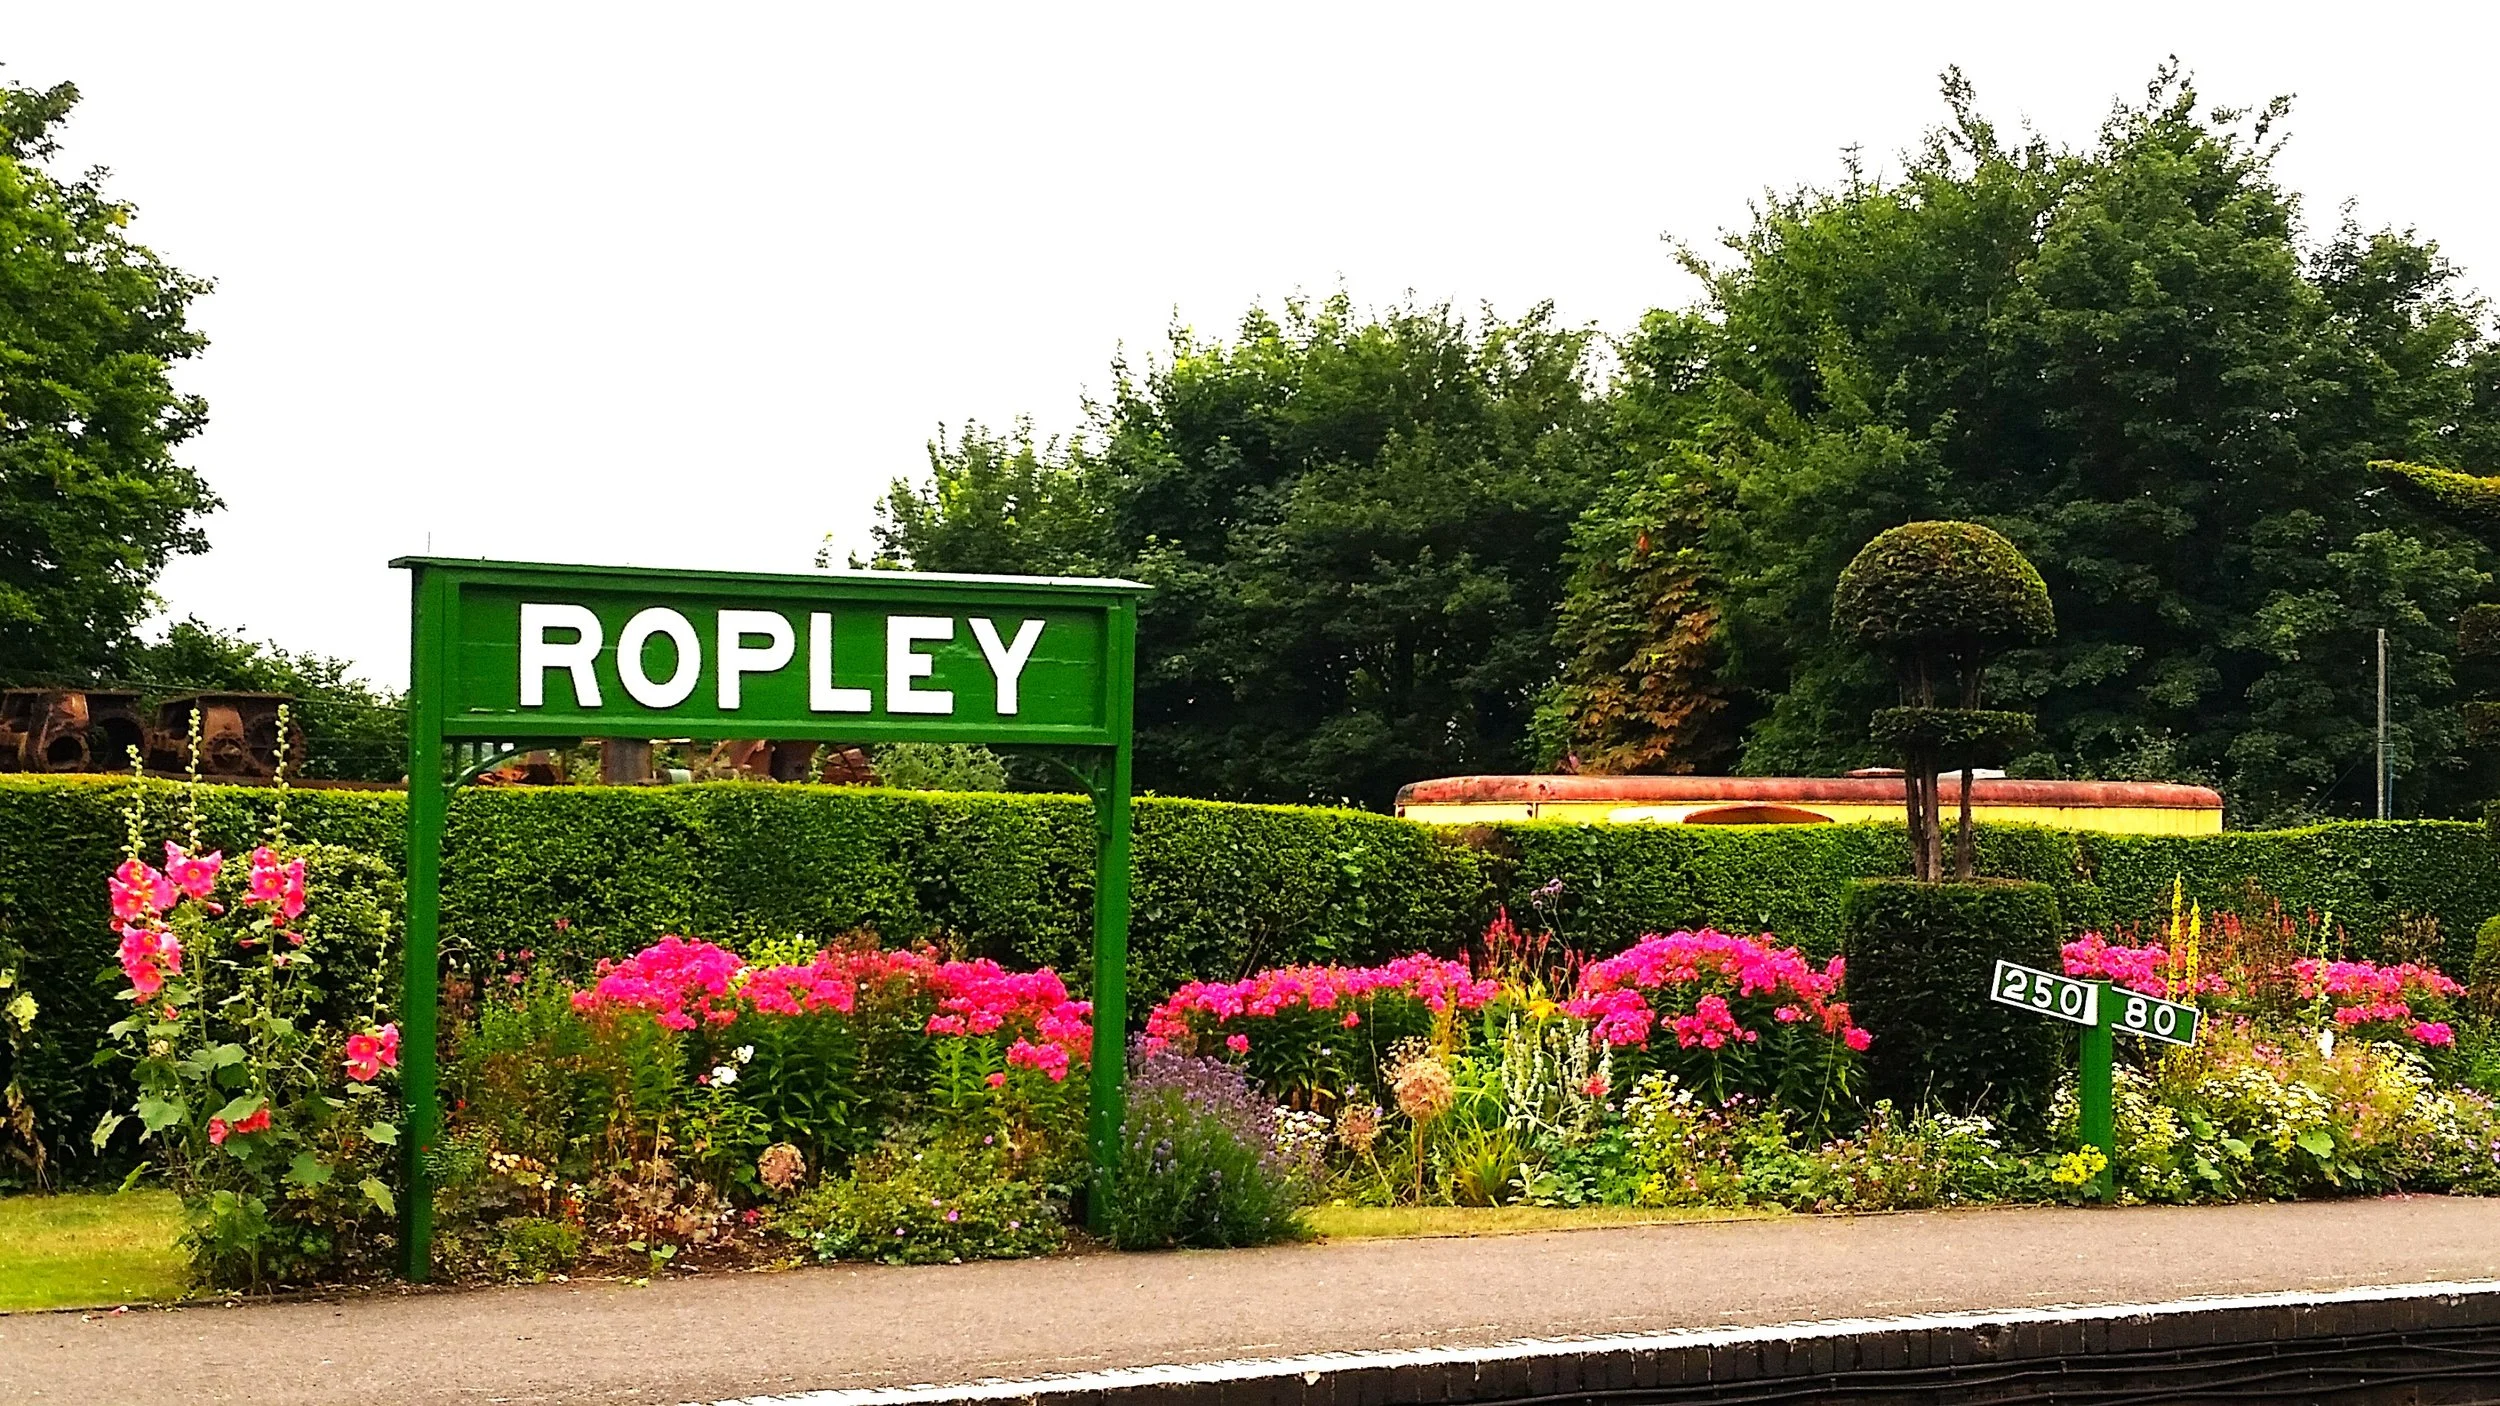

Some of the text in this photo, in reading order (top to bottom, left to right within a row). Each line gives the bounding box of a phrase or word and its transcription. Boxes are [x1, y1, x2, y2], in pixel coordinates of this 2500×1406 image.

[519, 602, 1047, 715] ROPLEY
[2002, 969, 2083, 1016] 250
[2124, 997, 2176, 1036] 80
